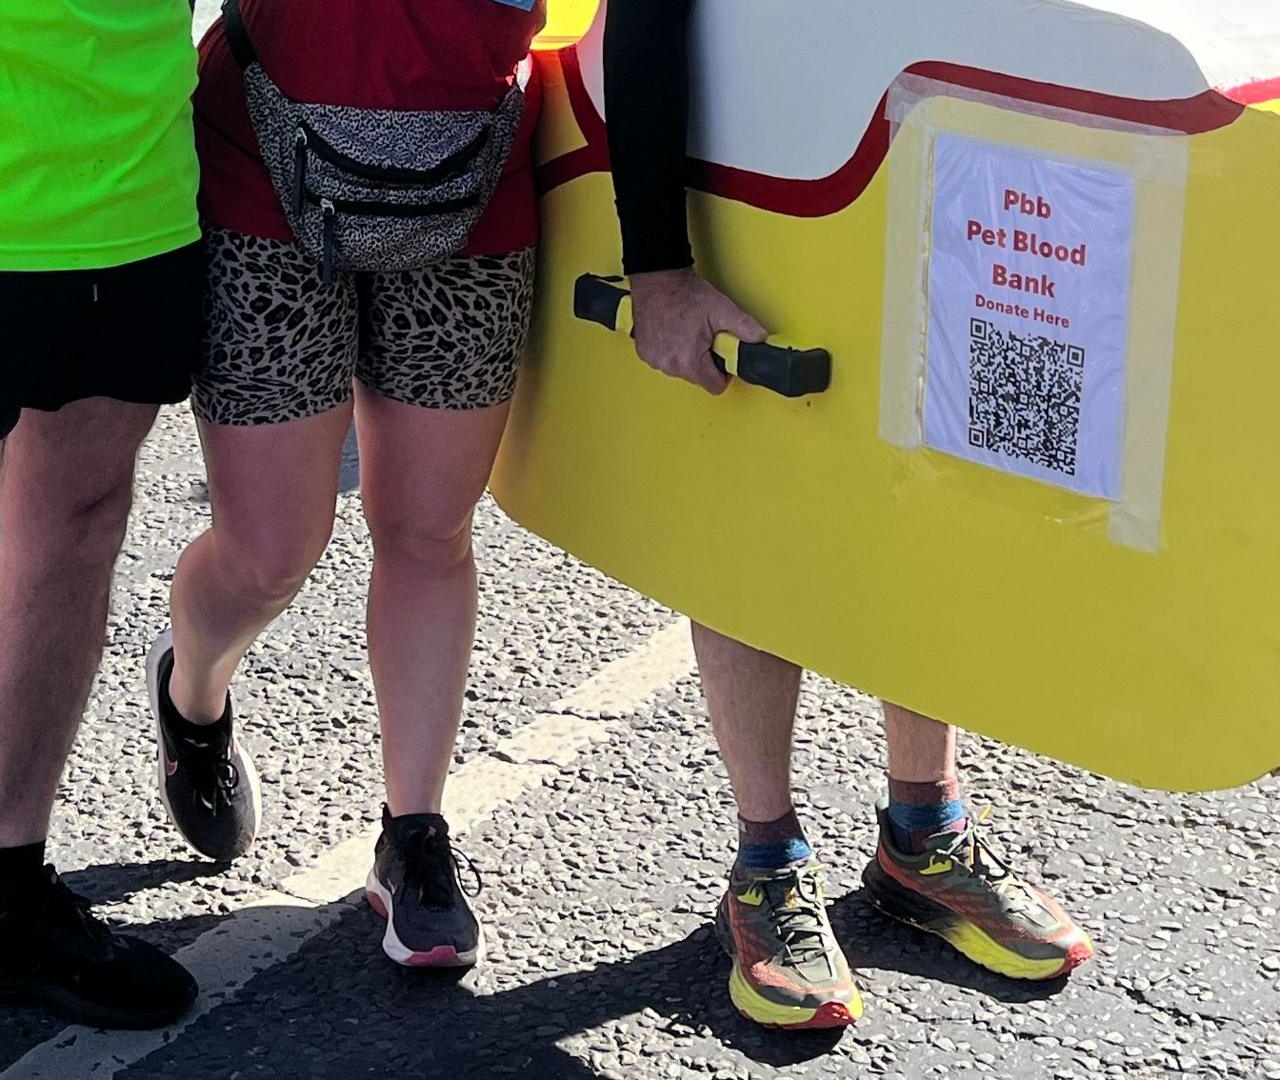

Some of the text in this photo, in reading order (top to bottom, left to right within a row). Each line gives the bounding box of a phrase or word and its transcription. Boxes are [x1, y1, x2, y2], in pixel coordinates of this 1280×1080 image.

[1004, 189, 1052, 219] Pbb
[967, 219, 1087, 266] Pet Blood
[992, 263, 1056, 298] Bank
[975, 294, 1070, 328] Donate Here
